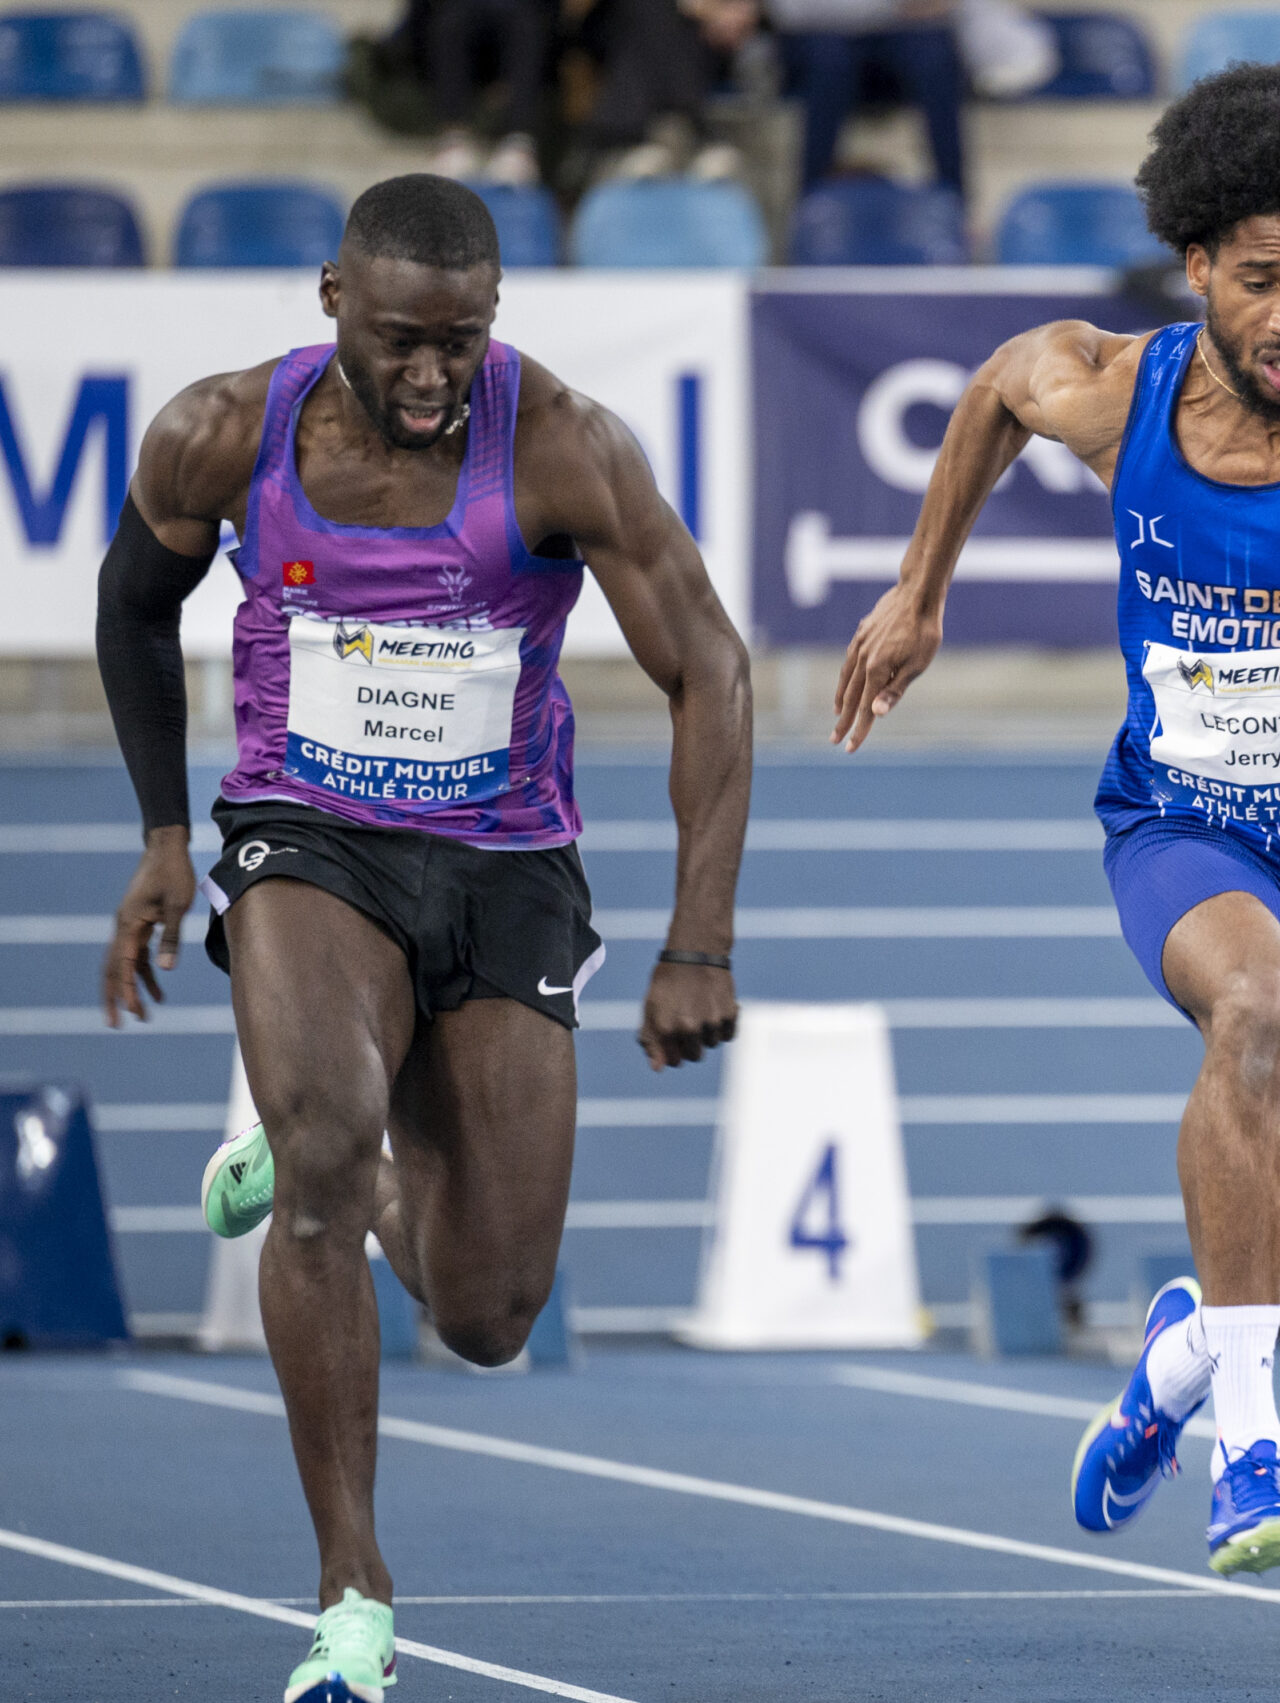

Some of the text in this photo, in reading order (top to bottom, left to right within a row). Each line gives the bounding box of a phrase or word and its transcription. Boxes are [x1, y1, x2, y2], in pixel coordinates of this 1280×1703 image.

[1135, 569, 1236, 611] SAINT
[378, 639, 475, 659] MEETING
[357, 686, 456, 711] DIAGNE
[364, 720, 444, 743] Marcel
[301, 742, 495, 782] CRÉDIT MUTUEL
[322, 772, 468, 801] ATHLÉ TOUR
[1167, 769, 1247, 803] CRÉDIT
[1192, 795, 1259, 821] ATHLÉ
[788, 1141, 850, 1278] 4
